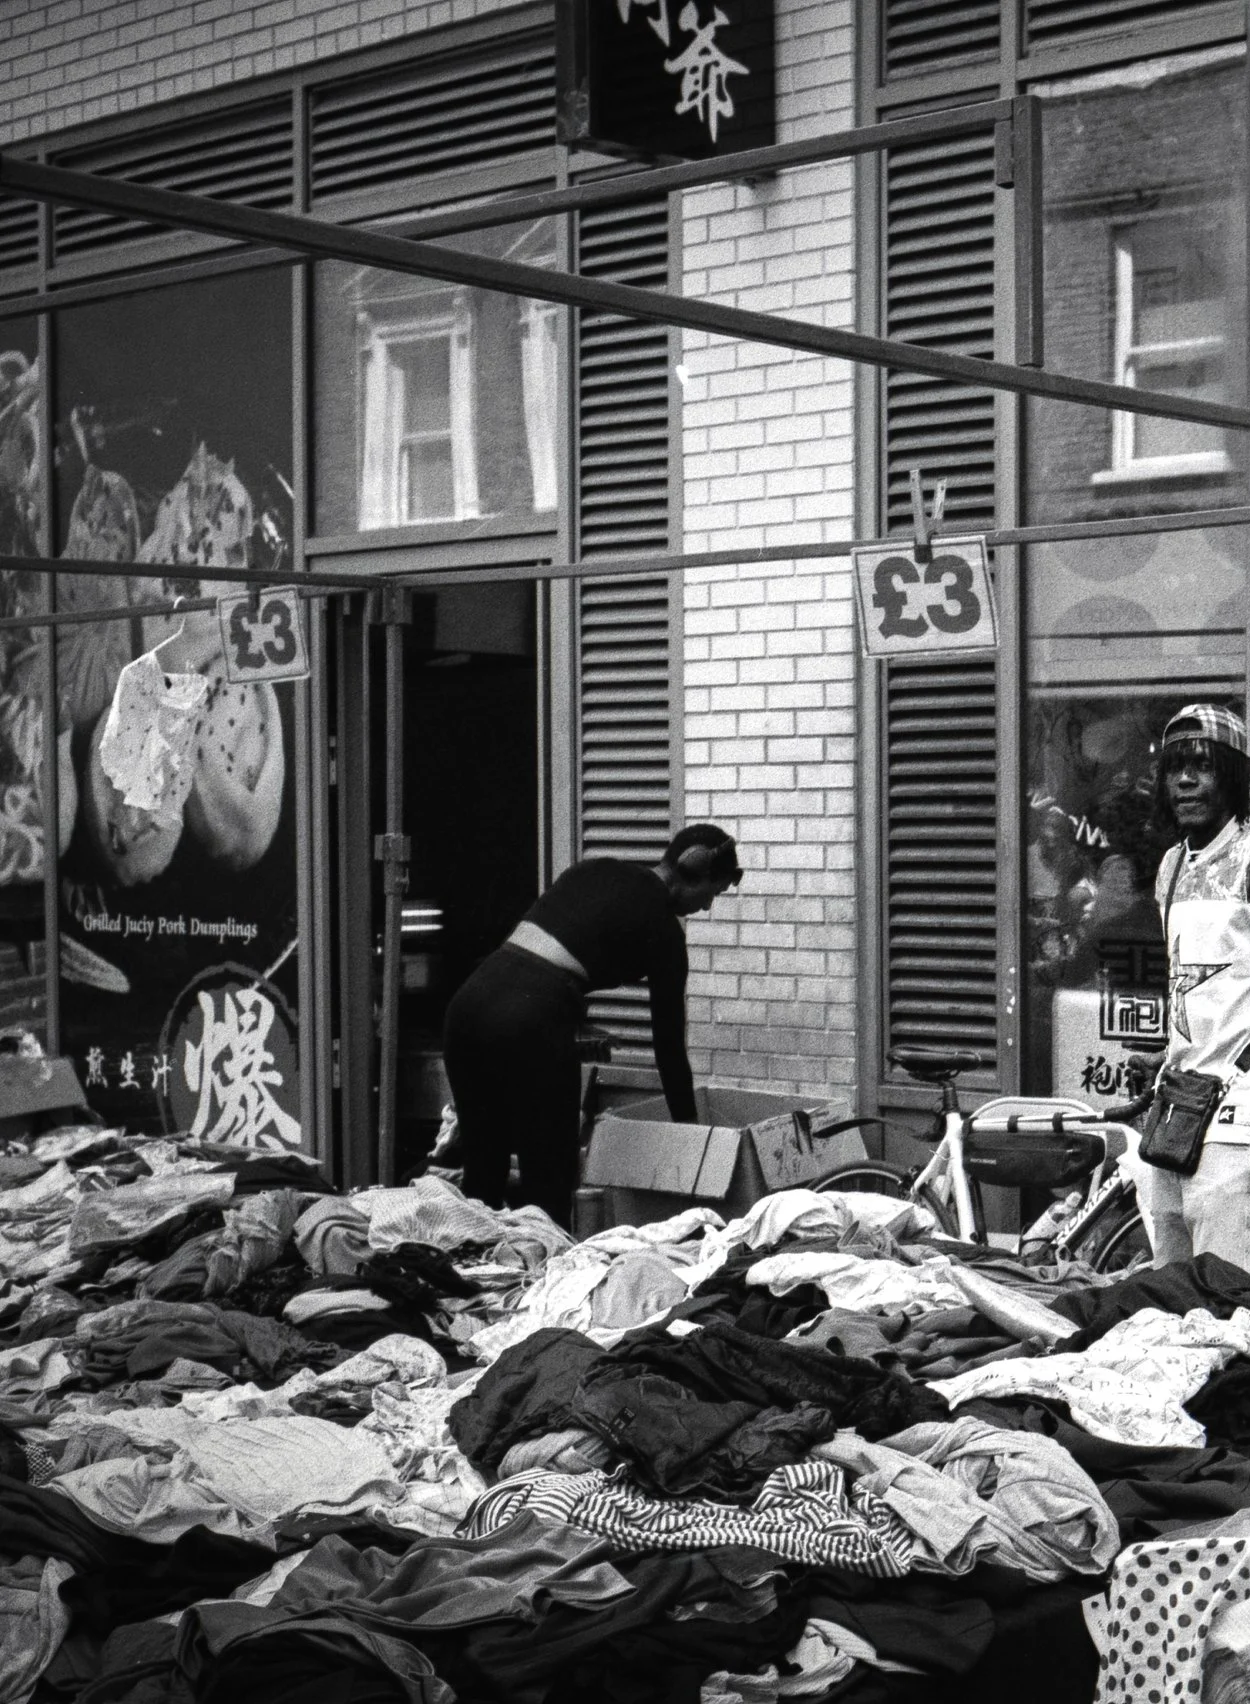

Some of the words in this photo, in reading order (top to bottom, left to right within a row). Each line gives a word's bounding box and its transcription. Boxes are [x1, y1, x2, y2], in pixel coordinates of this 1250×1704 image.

[617, 0, 750, 143] 爺
[229, 599, 297, 670] £3
[872, 553, 982, 640] £3
[83, 913, 122, 932] Grilled
[123, 914, 154, 942] Juciy
[158, 914, 187, 935] Pork
[190, 916, 258, 945] Dumplings
